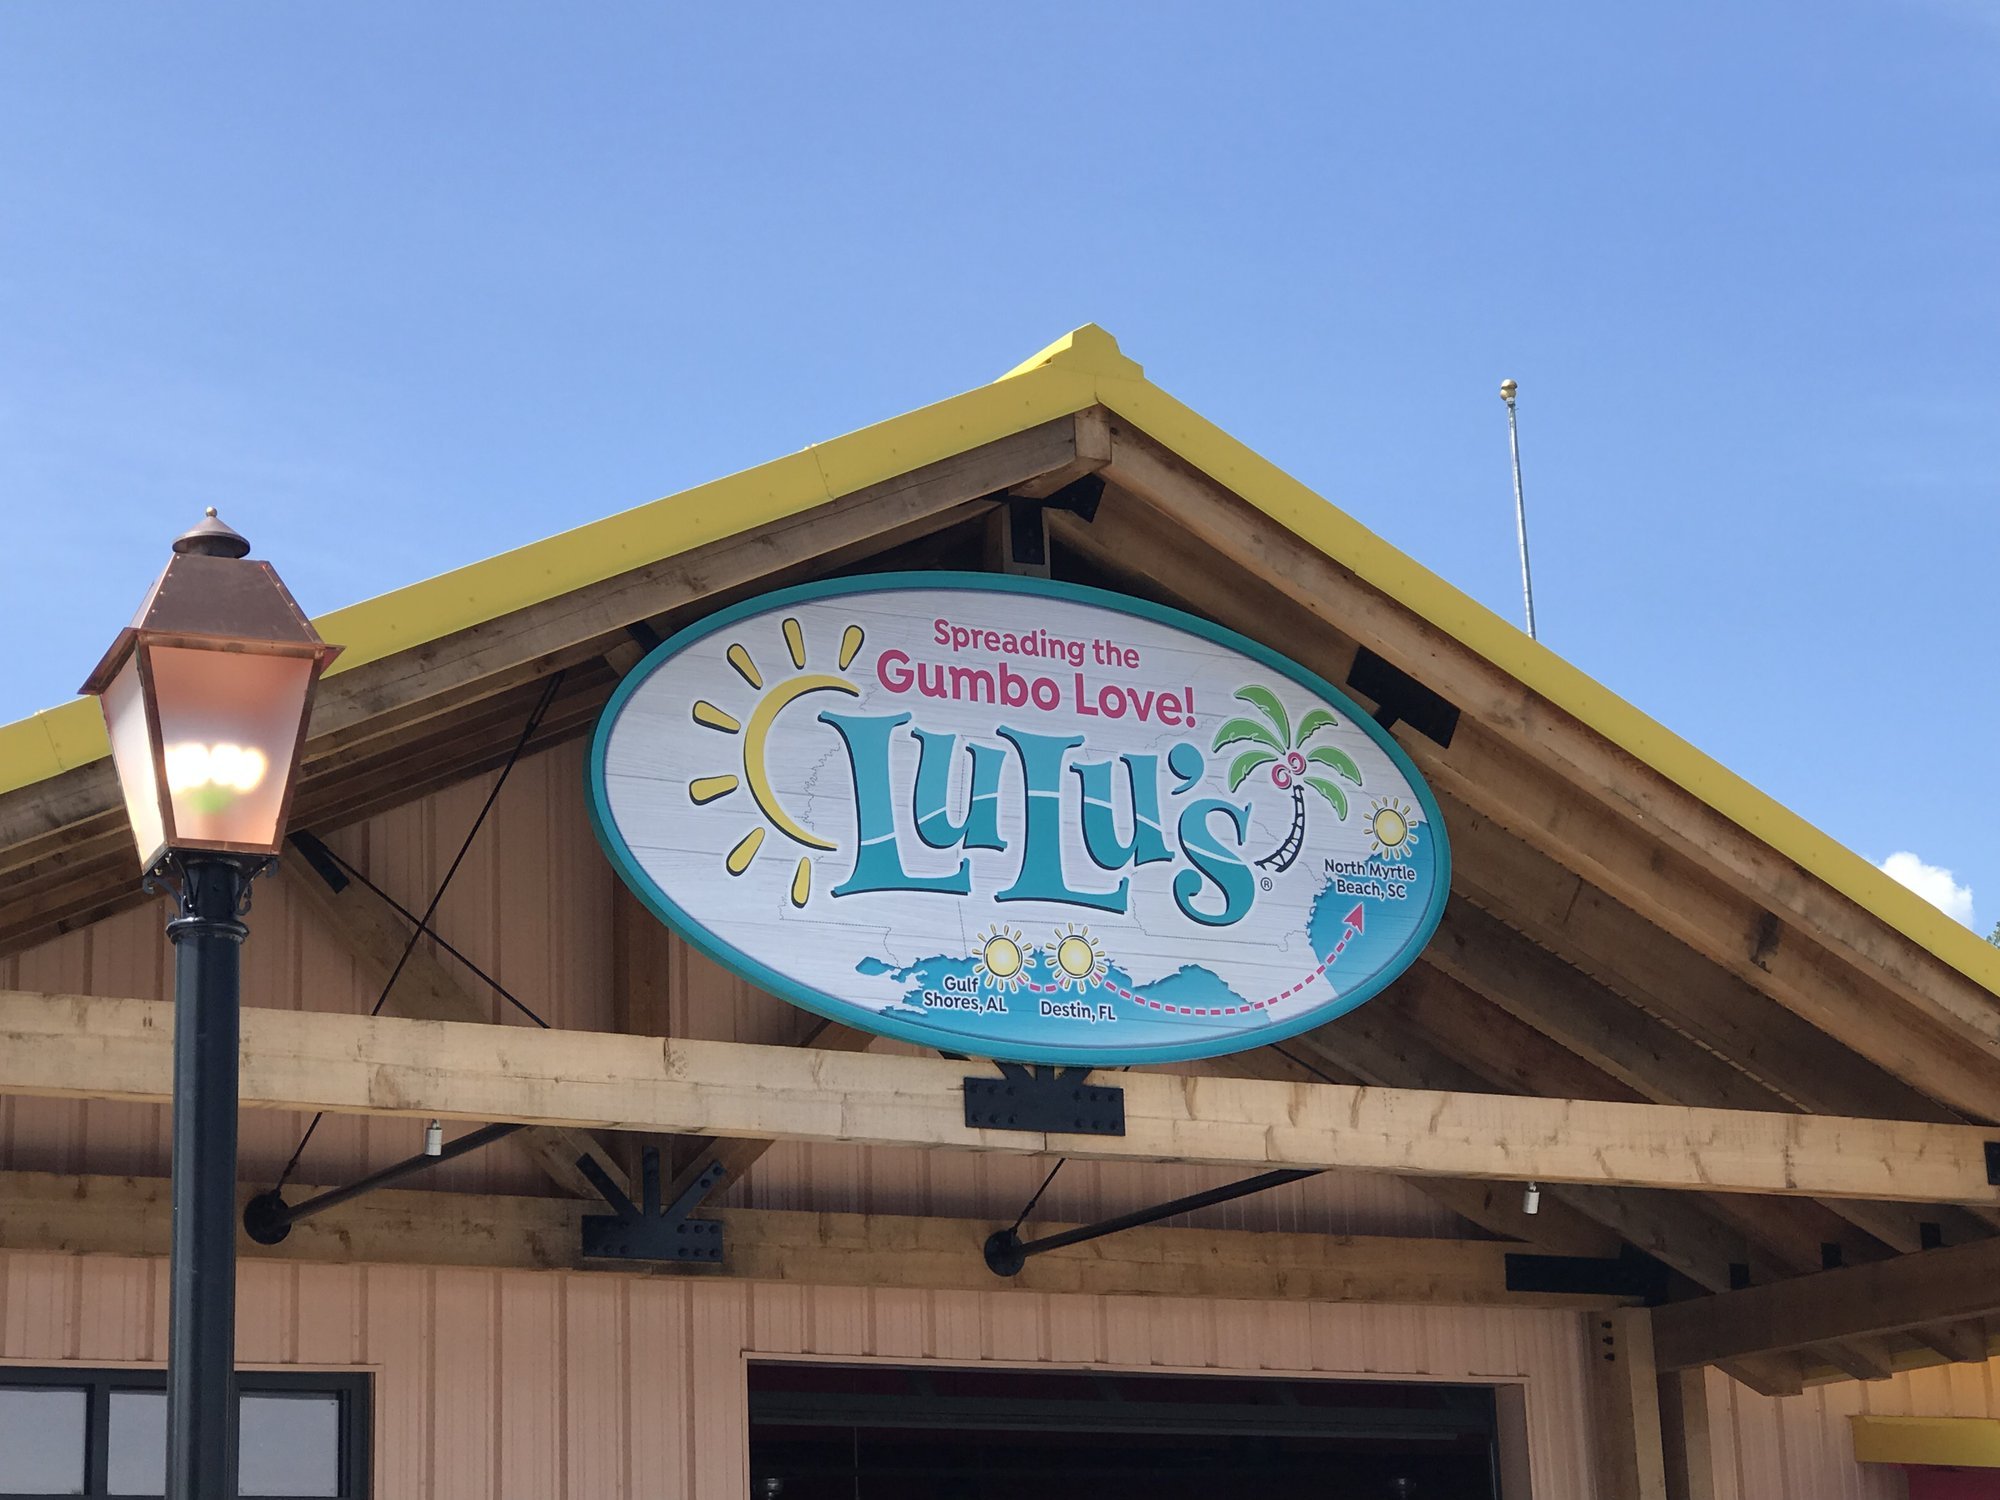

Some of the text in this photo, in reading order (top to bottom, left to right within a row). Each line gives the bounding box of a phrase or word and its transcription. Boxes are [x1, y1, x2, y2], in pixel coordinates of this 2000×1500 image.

[933, 618, 1140, 668] Spreading the
[877, 649, 1196, 728] Gumbo Love!
[817, 711, 1256, 926] LuLu's
[1324, 858, 1415, 880] North Myrtle
[1336, 879, 1406, 899] Beach, SC
[944, 976, 979, 993] Gulf
[923, 992, 1007, 1013] Shores, AL
[1040, 1001, 1116, 1022] Destin, FL
